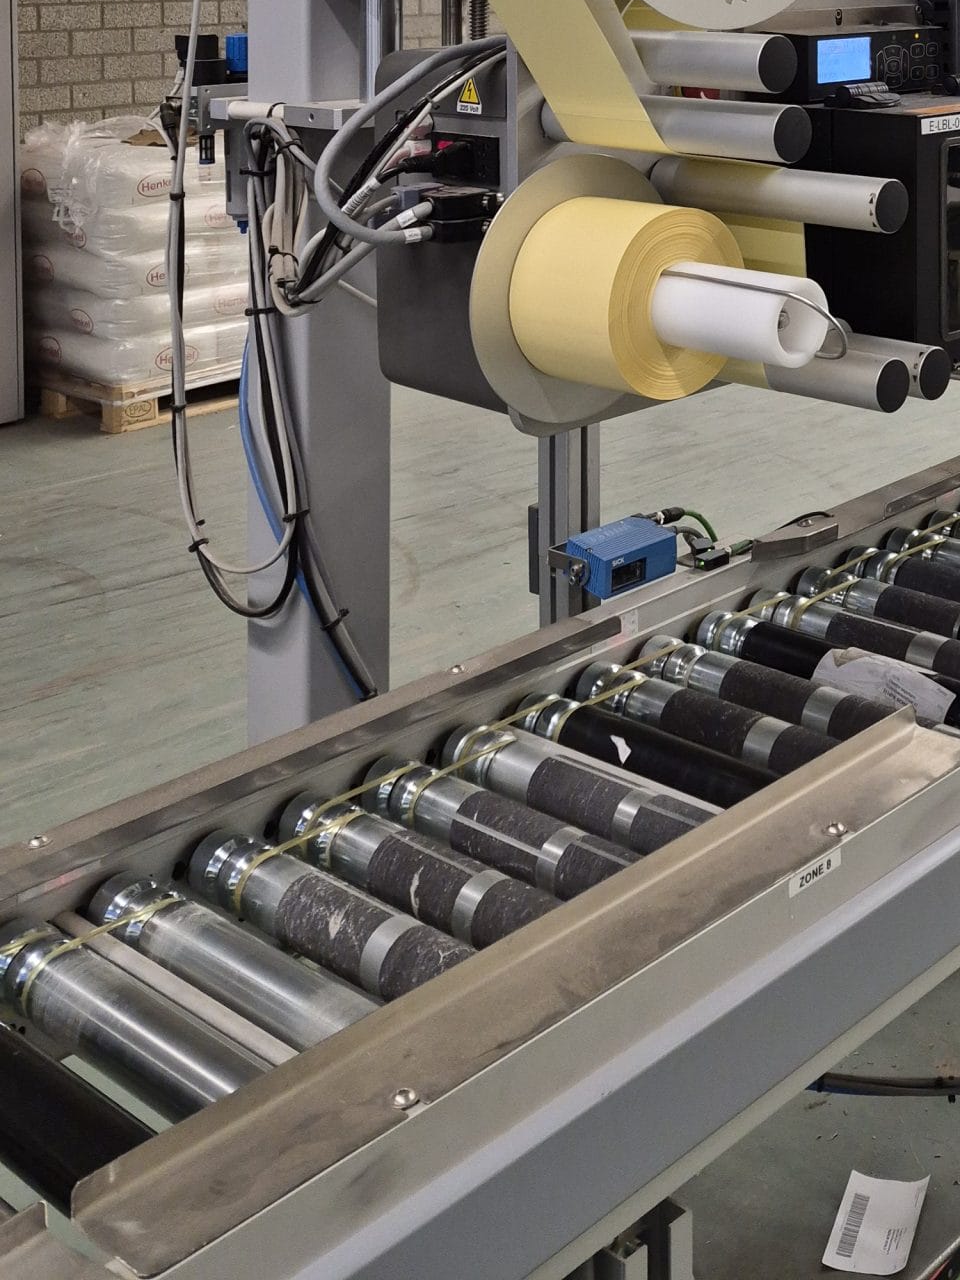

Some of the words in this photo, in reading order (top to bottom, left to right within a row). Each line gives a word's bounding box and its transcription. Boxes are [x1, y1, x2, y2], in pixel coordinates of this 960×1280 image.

[141, 178, 172, 192] Henk
[159, 351, 195, 365] Heel
[611, 557, 625, 568] SICK
[799, 863, 825, 889] ZONE
